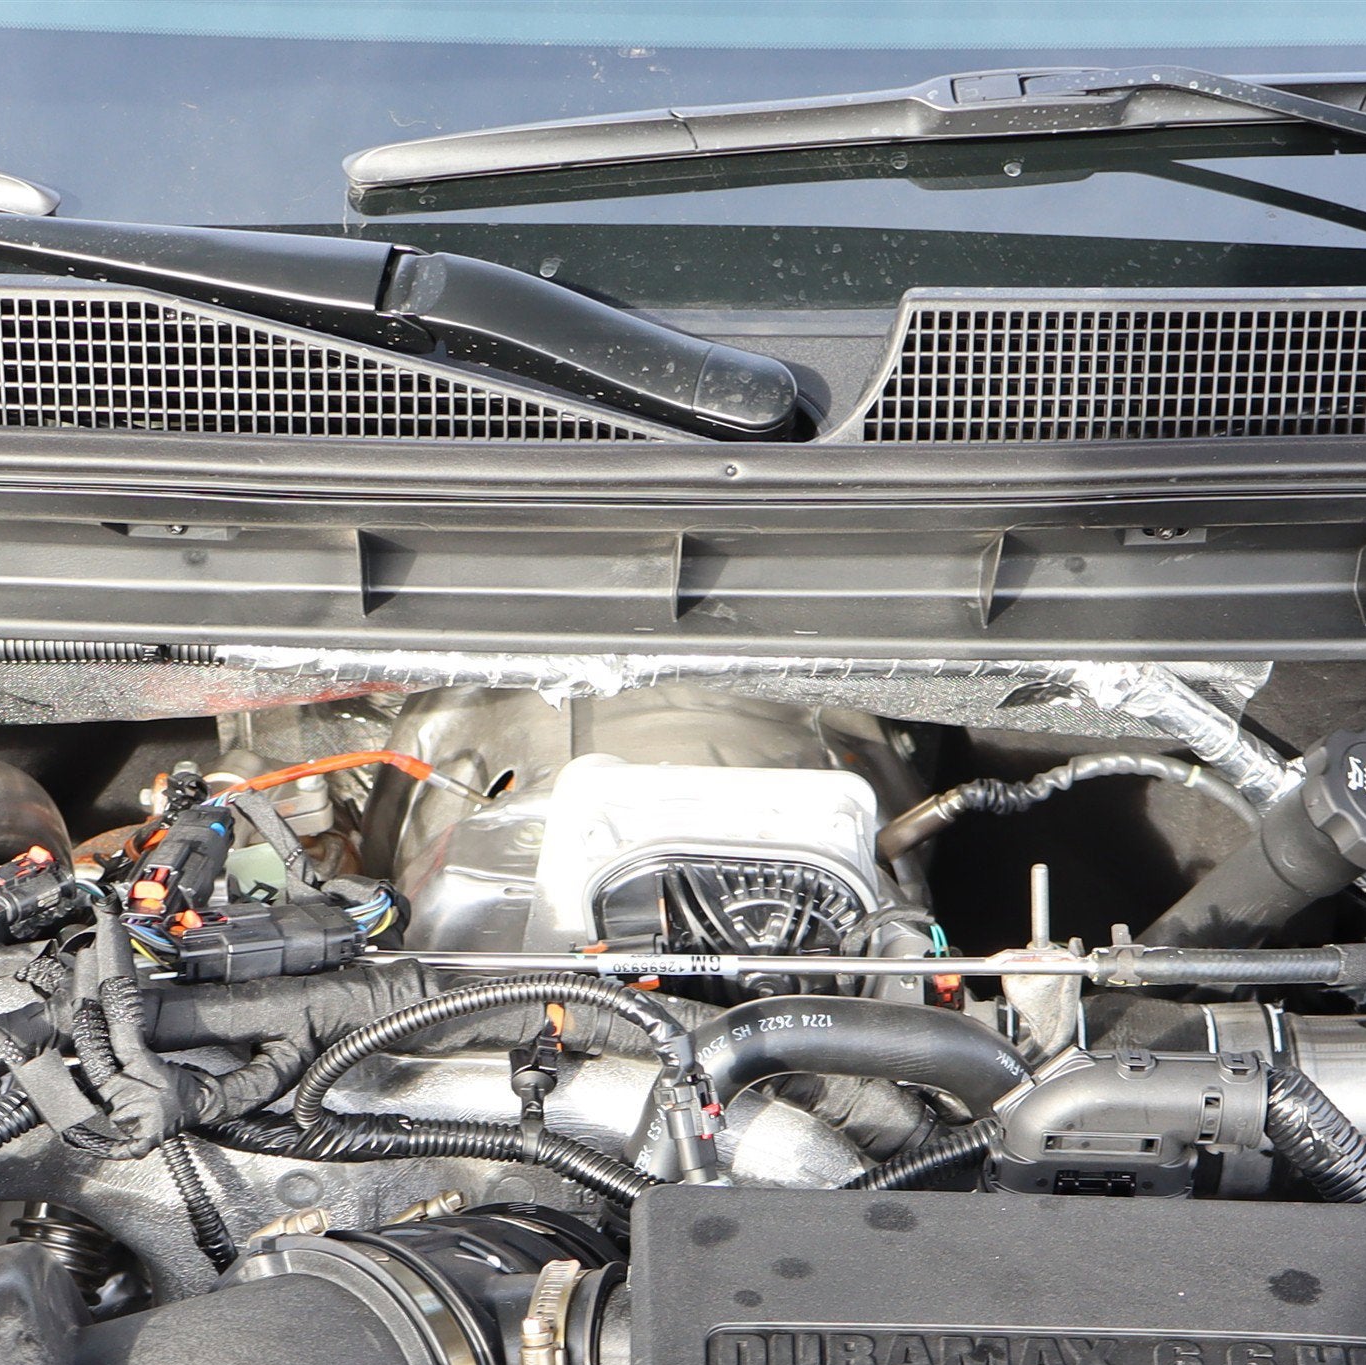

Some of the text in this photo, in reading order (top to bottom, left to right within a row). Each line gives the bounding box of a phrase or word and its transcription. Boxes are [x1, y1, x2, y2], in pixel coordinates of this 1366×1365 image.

[691, 955, 721, 972] GM
[757, 1014, 794, 1033] 2622
[800, 1013, 834, 1028] 1274
[731, 1023, 753, 1041] HS
